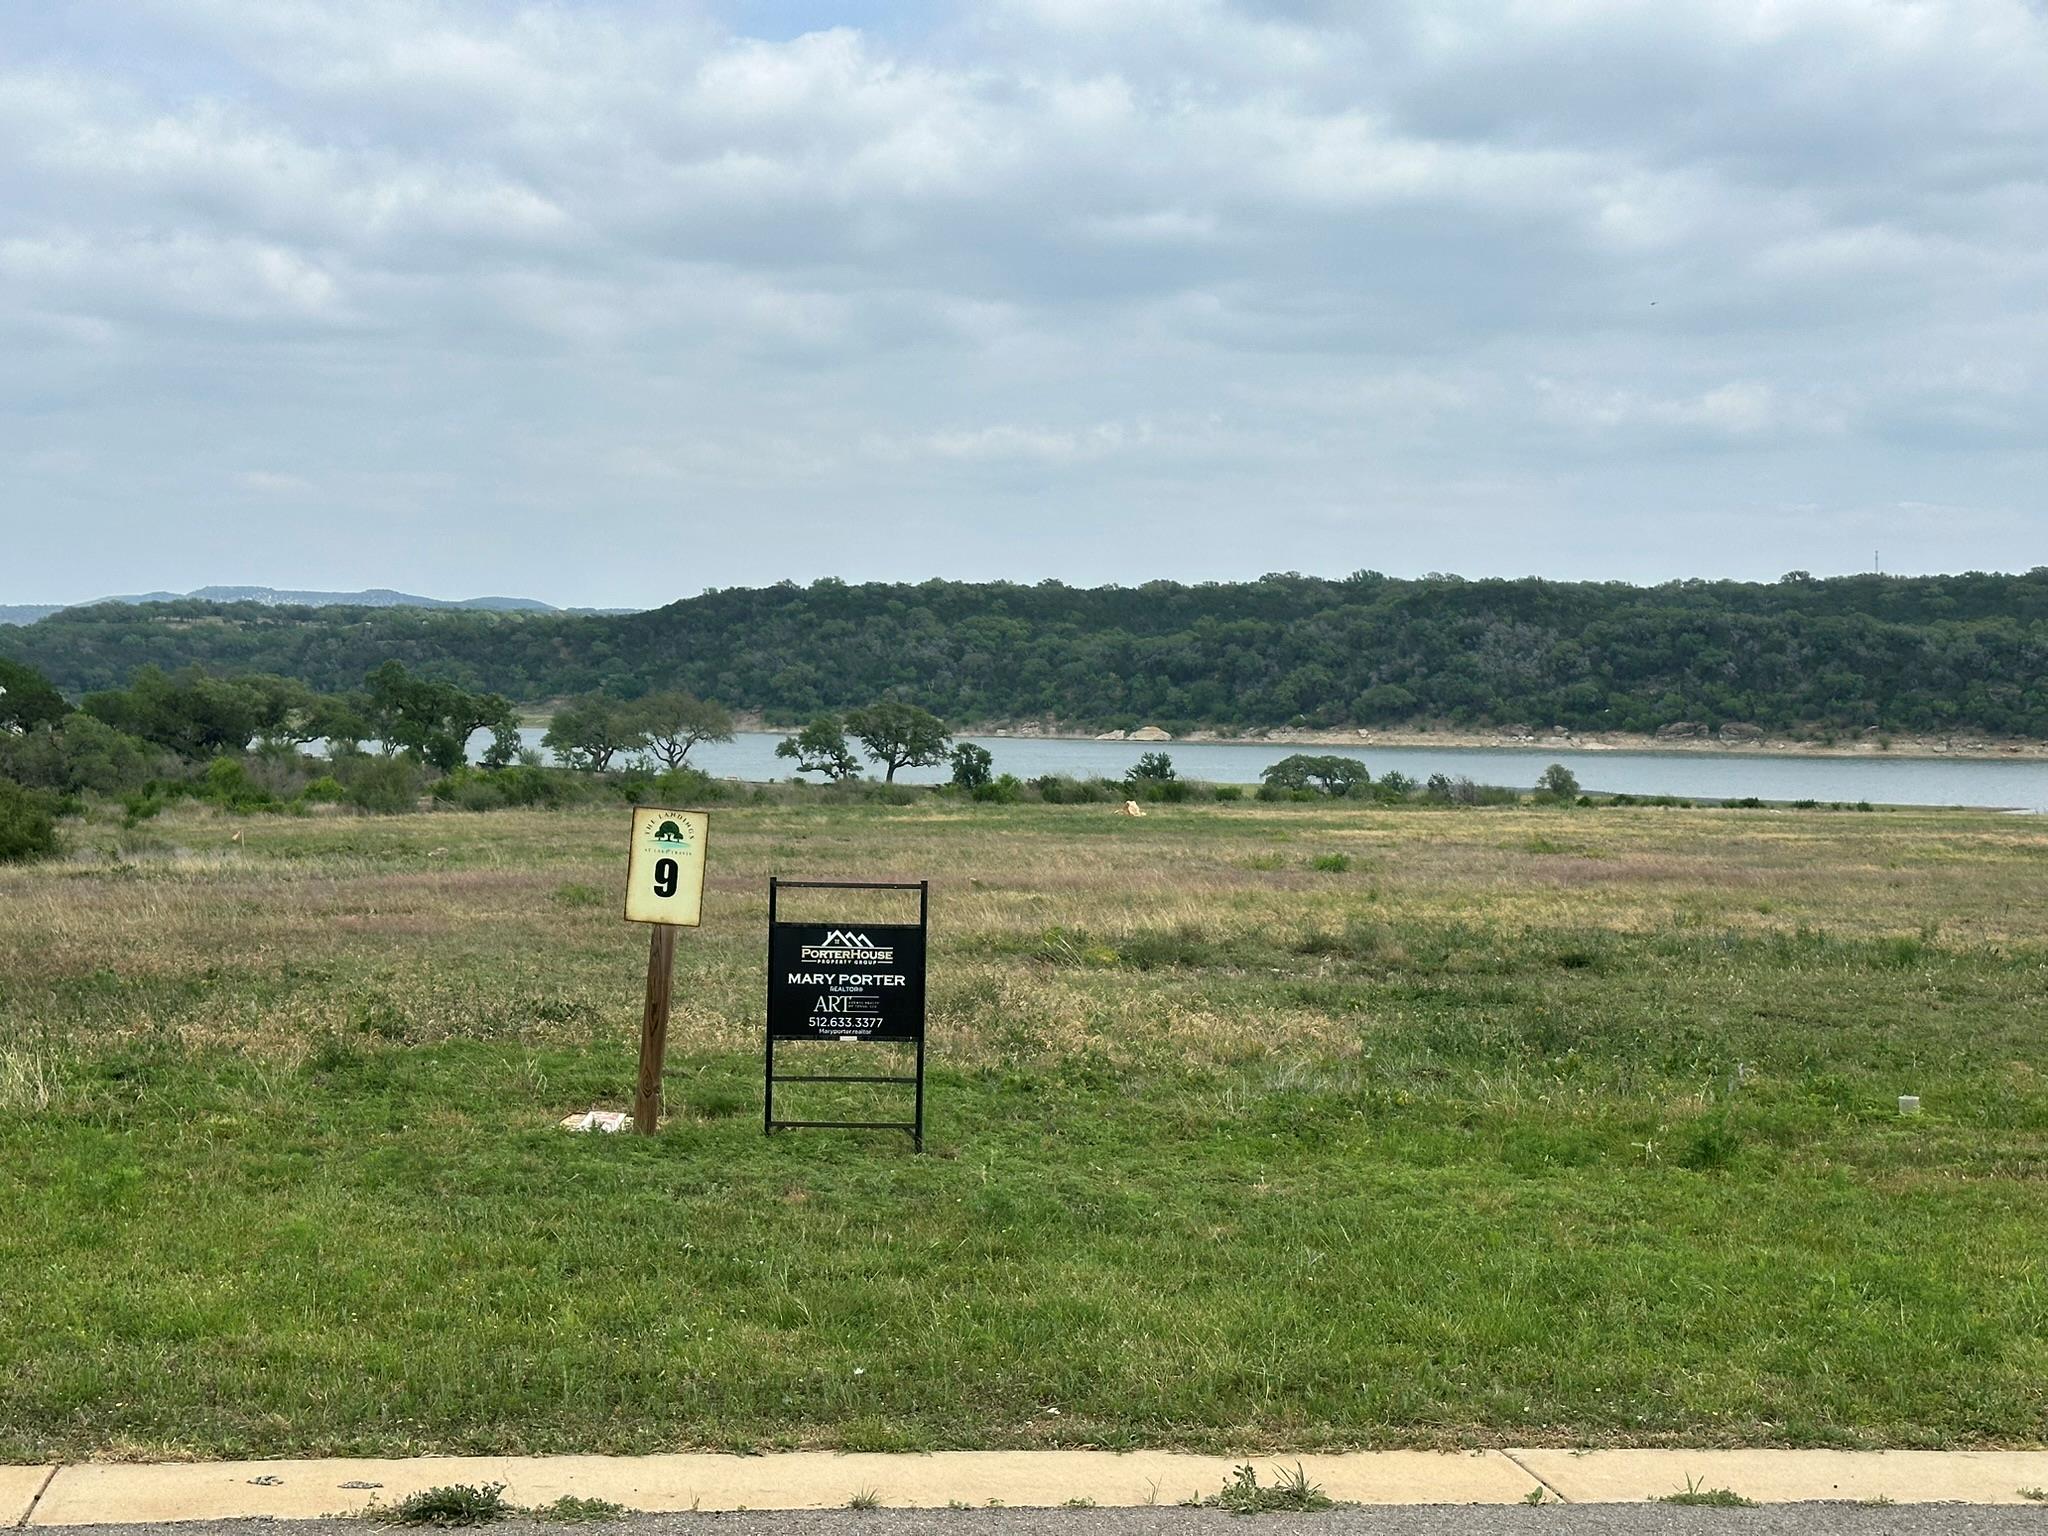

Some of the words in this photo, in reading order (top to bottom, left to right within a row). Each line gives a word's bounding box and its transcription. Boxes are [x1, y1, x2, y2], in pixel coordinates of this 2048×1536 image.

[658, 812, 695, 840] LANDINGS
[653, 858, 679, 898] 9
[788, 973, 836, 985] MARY
[838, 974, 906, 986] PORTER
[813, 995, 852, 1013] ART
[808, 1016, 884, 1028] 512.633.3377
